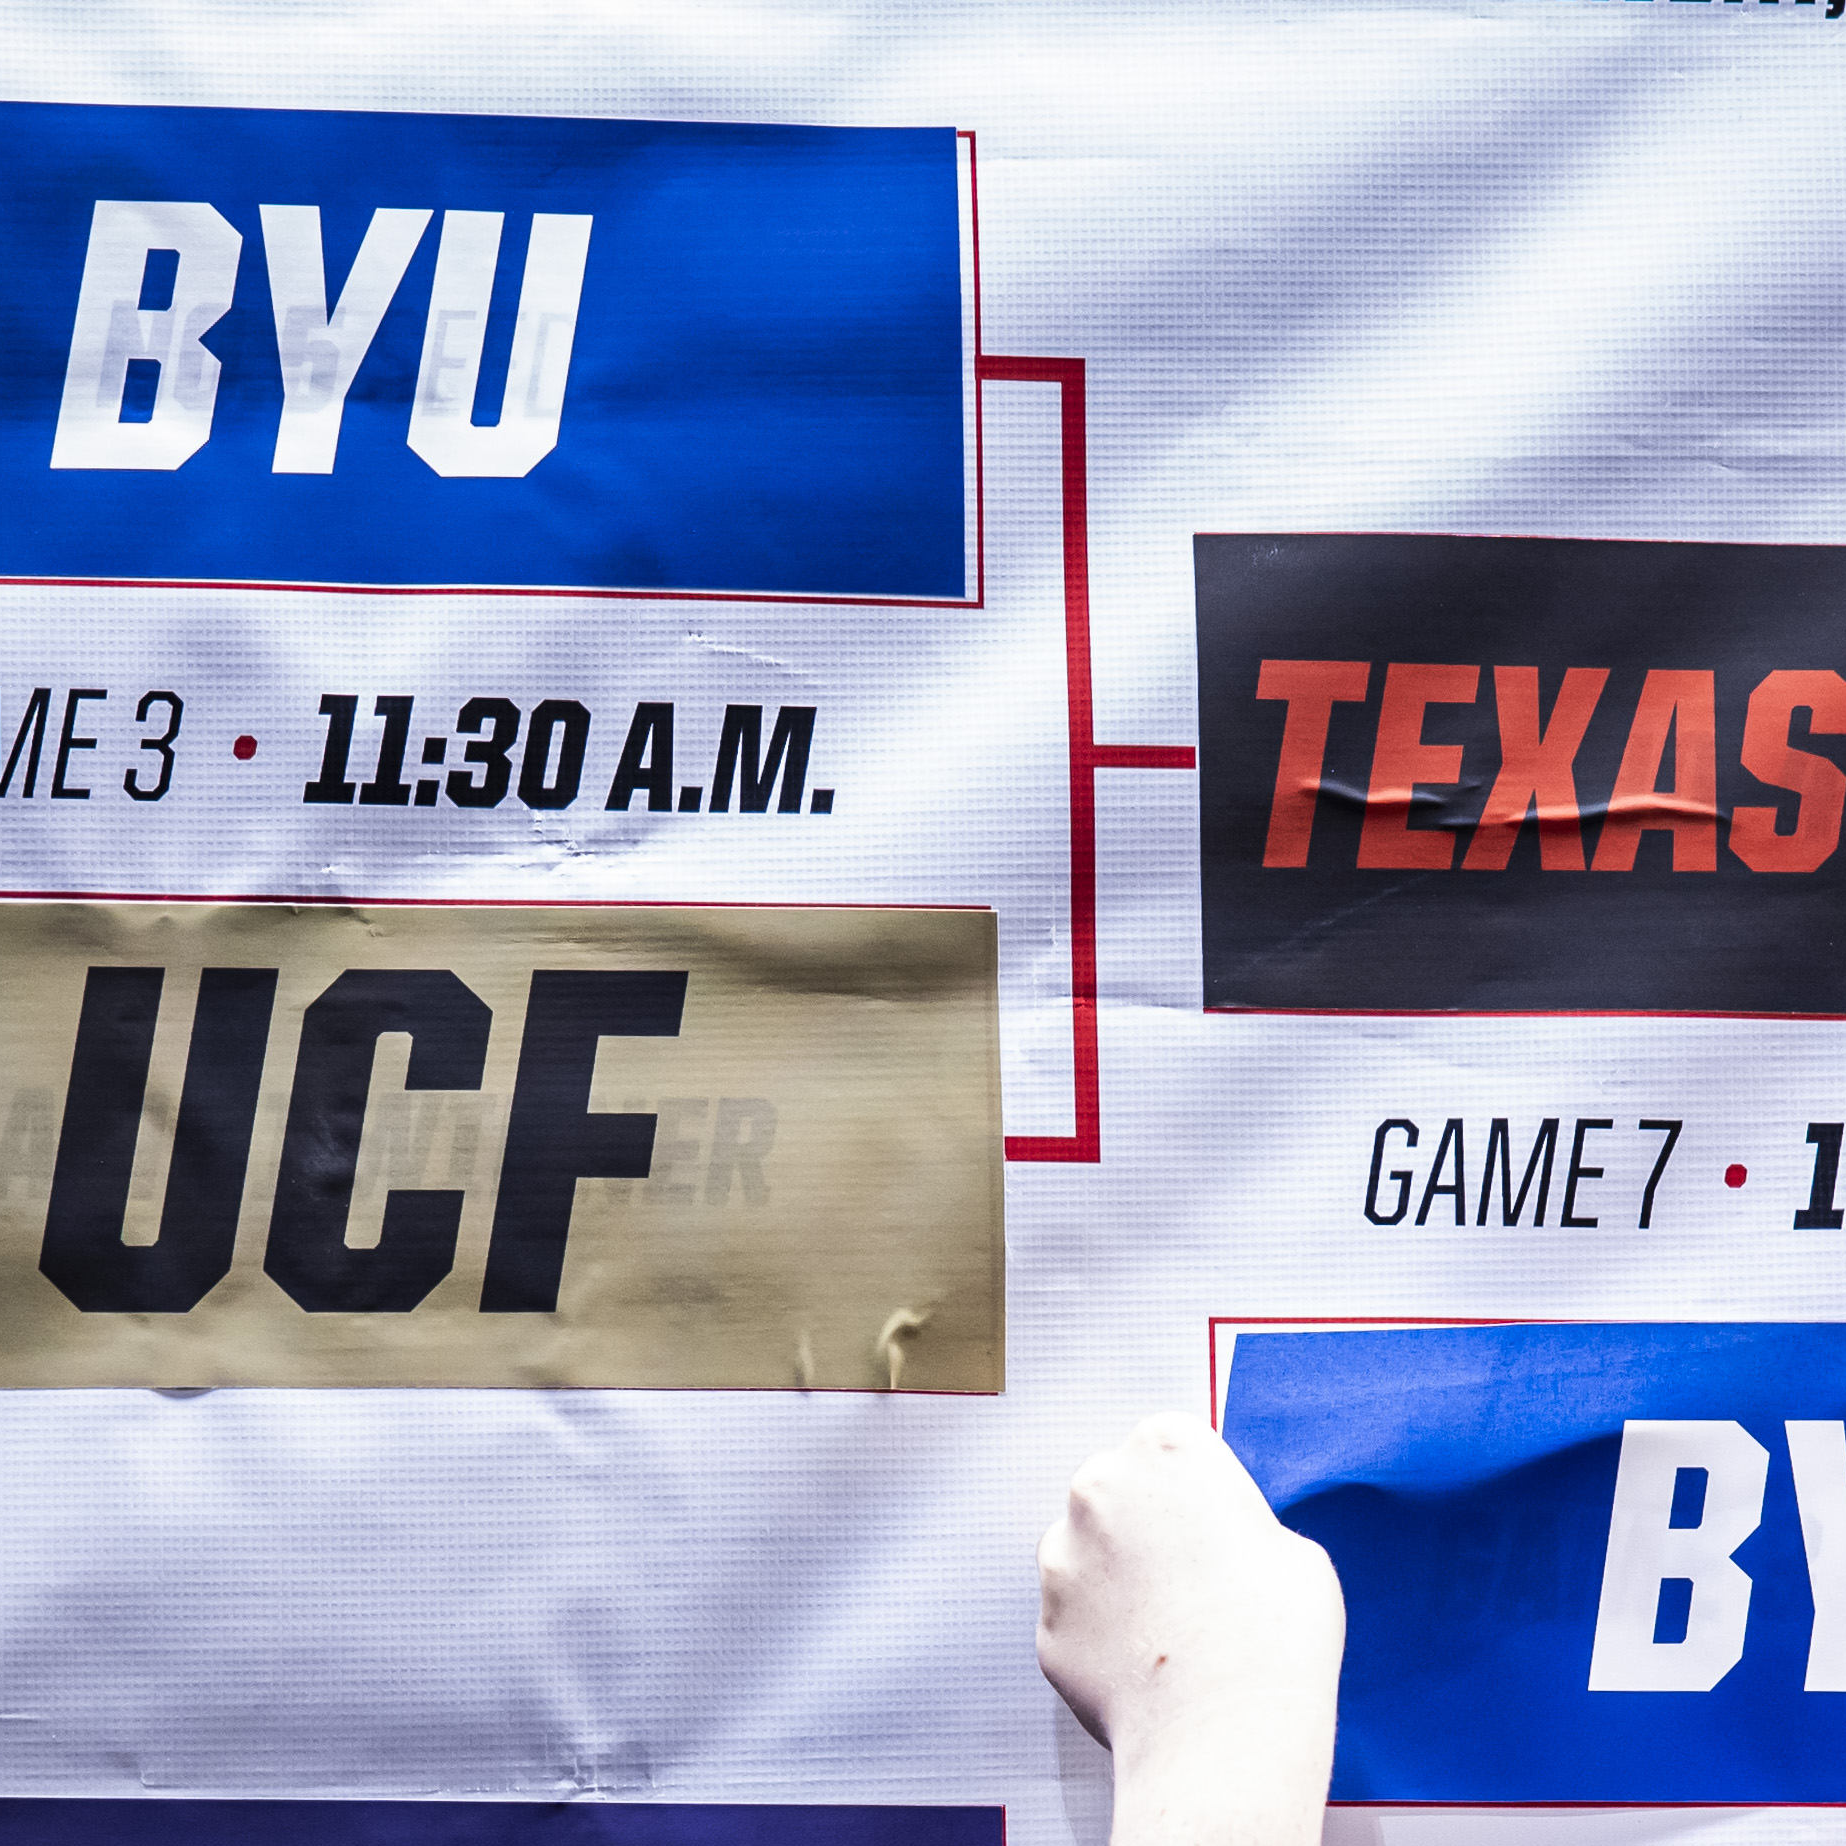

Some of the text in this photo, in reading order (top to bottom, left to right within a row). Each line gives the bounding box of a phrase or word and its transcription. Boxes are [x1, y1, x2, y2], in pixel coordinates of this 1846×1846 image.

[50, 199, 594, 477] BYU
[124, 690, 185, 801] 3
[302, 694, 592, 808] 11:30
[604, 703, 836, 814] A.M.
[38, 966, 690, 1313] UCF
[1362, 1117, 1614, 1228] GAME
[1636, 1119, 1684, 1229] 7
